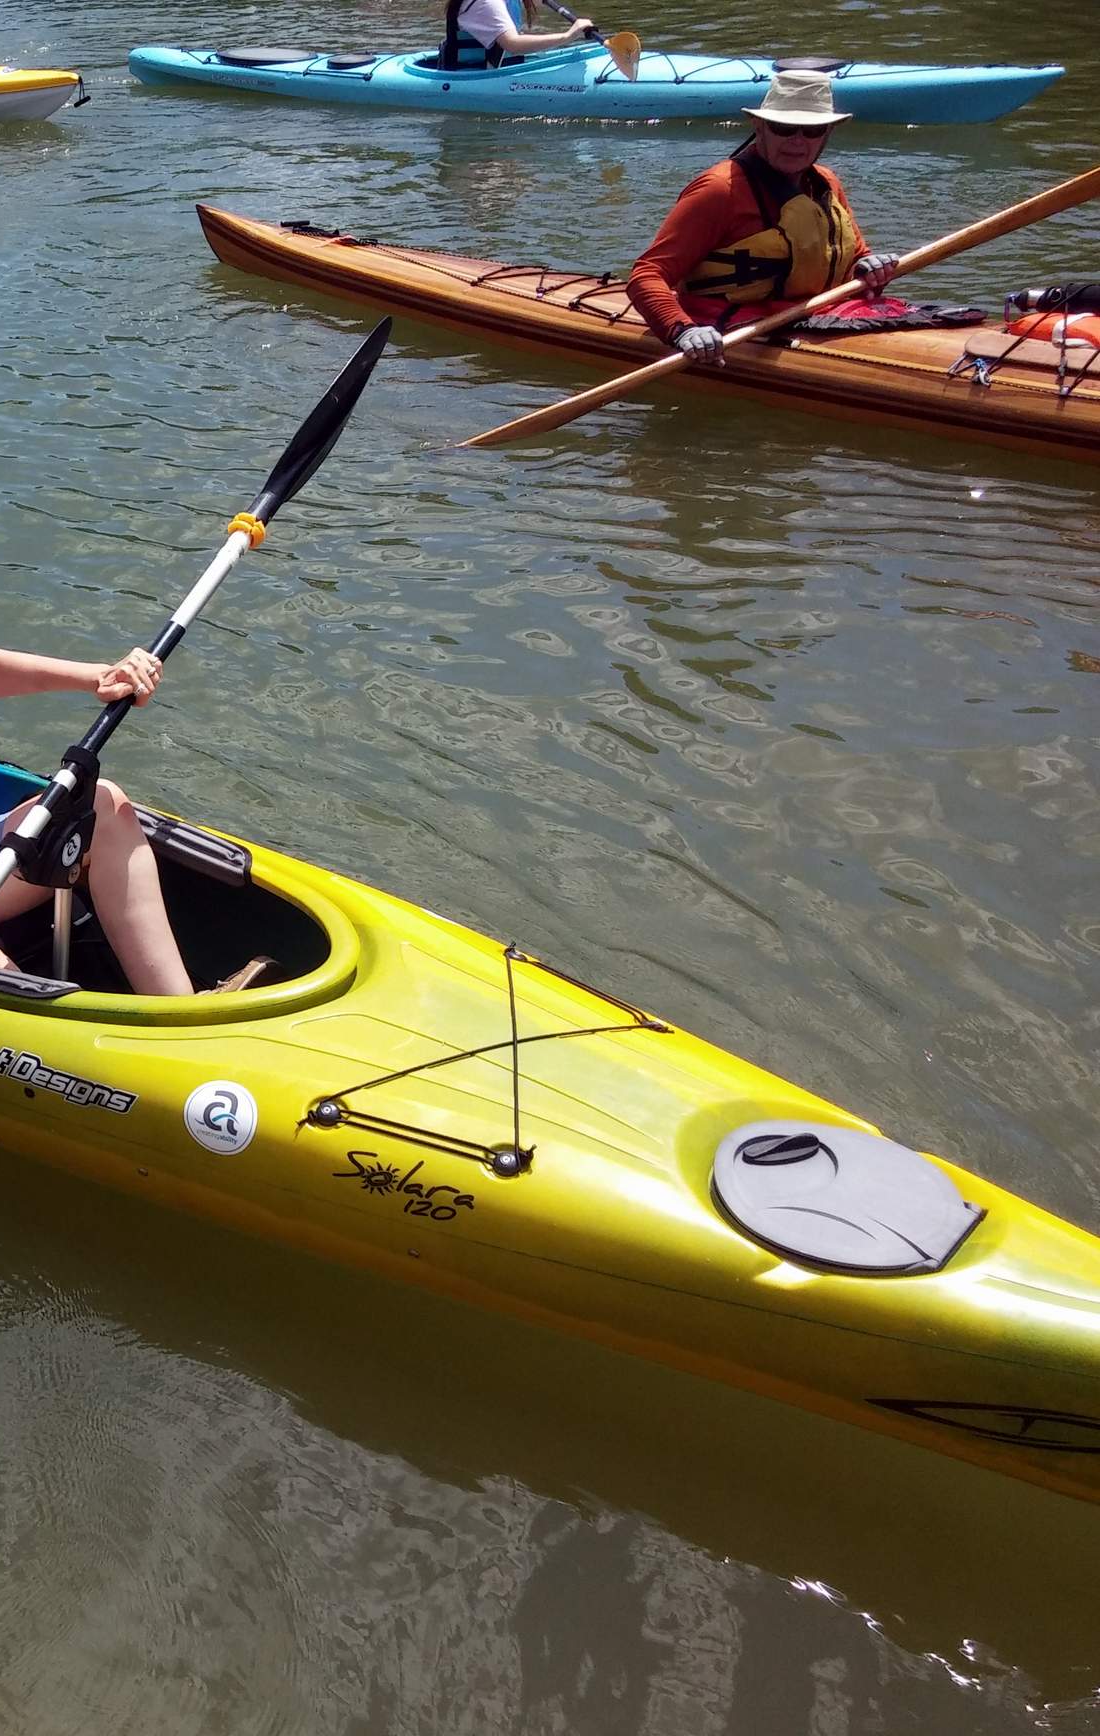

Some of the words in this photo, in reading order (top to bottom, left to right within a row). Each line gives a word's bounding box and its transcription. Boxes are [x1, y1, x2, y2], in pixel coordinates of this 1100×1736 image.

[10, 1051, 137, 1113] Designs
[332, 1151, 475, 1210] Solara
[404, 1200, 457, 1221] 120
